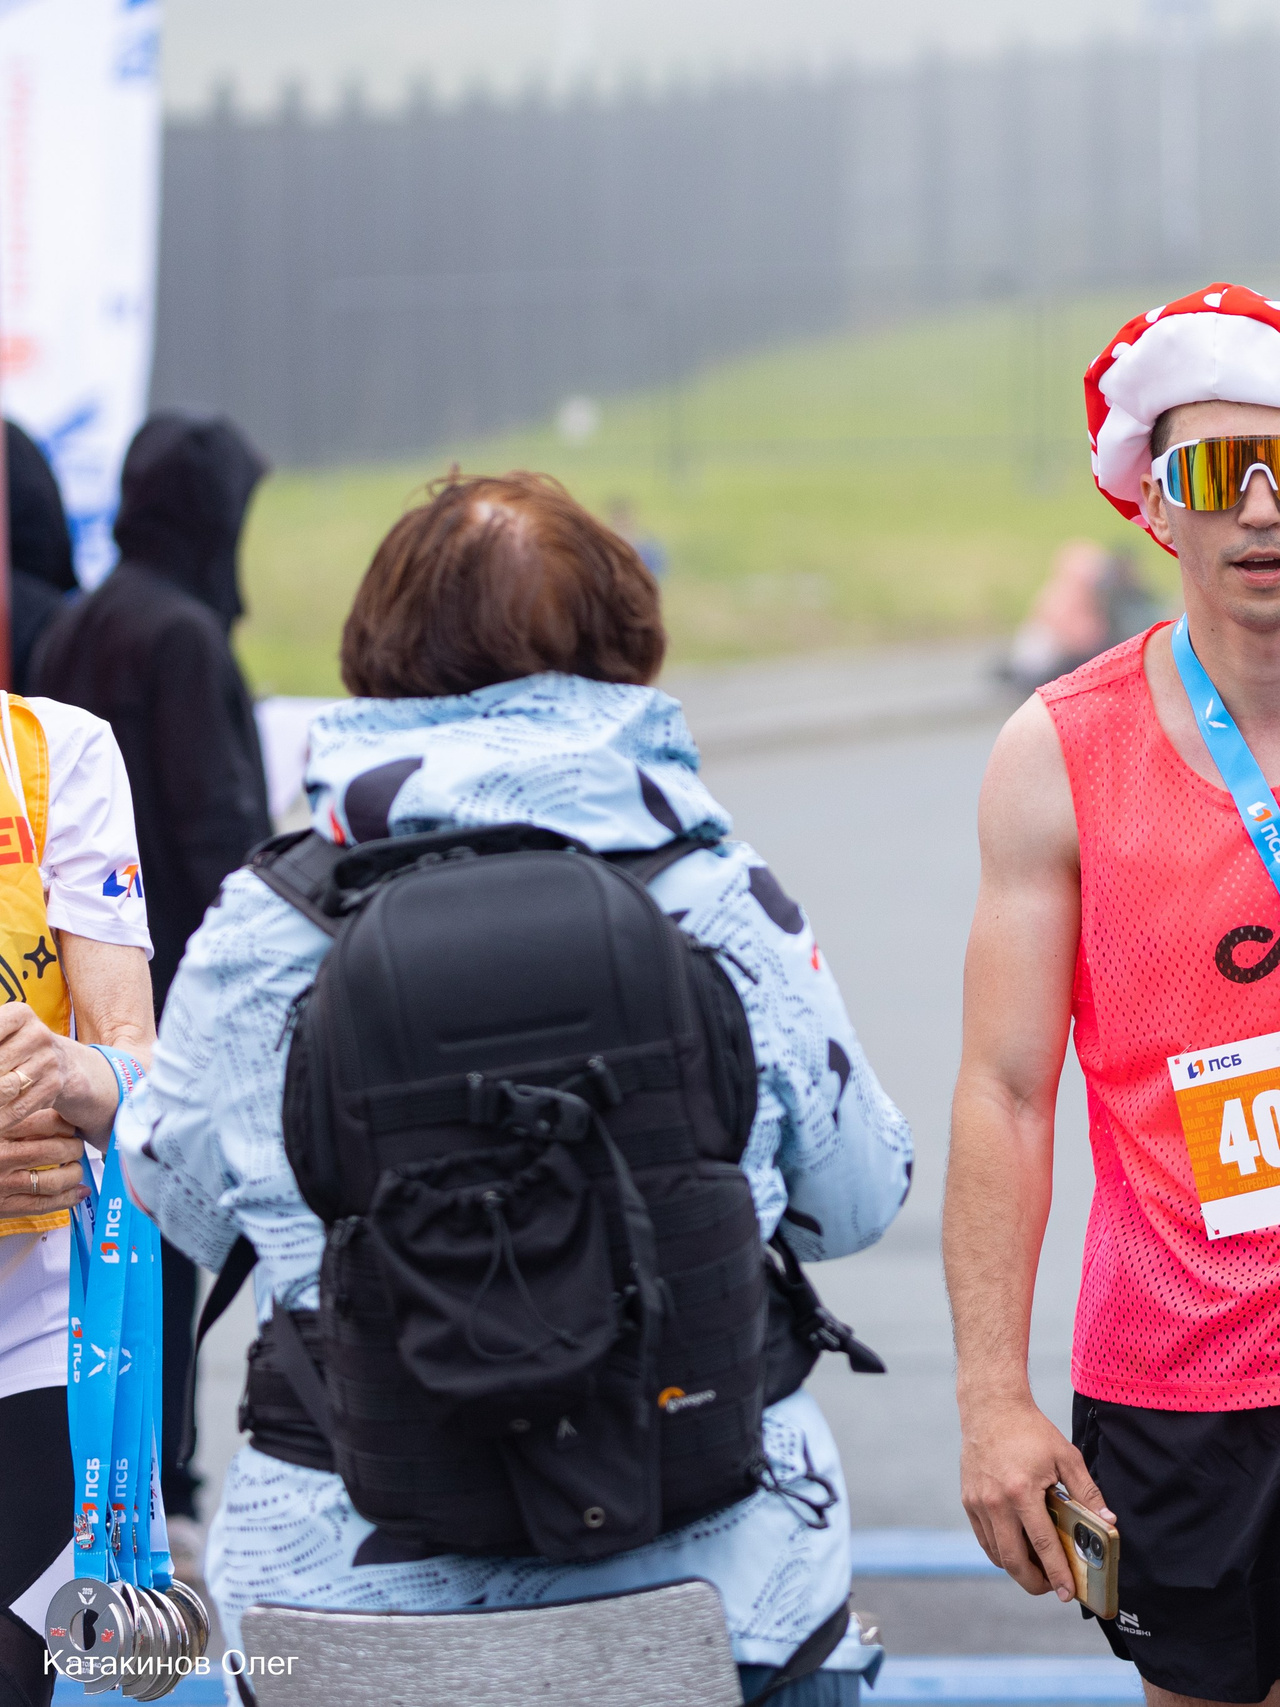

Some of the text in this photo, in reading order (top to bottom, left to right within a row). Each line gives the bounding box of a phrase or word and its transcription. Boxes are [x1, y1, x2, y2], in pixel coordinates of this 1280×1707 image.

[1208, 1054, 1242, 1072] ПСБ
[105, 1197, 122, 1237] ПСБ
[85, 1457, 100, 1497] ПСБ
[115, 1457, 128, 1497] ПСБ
[1115, 1621, 1152, 1637] ORDSKI
